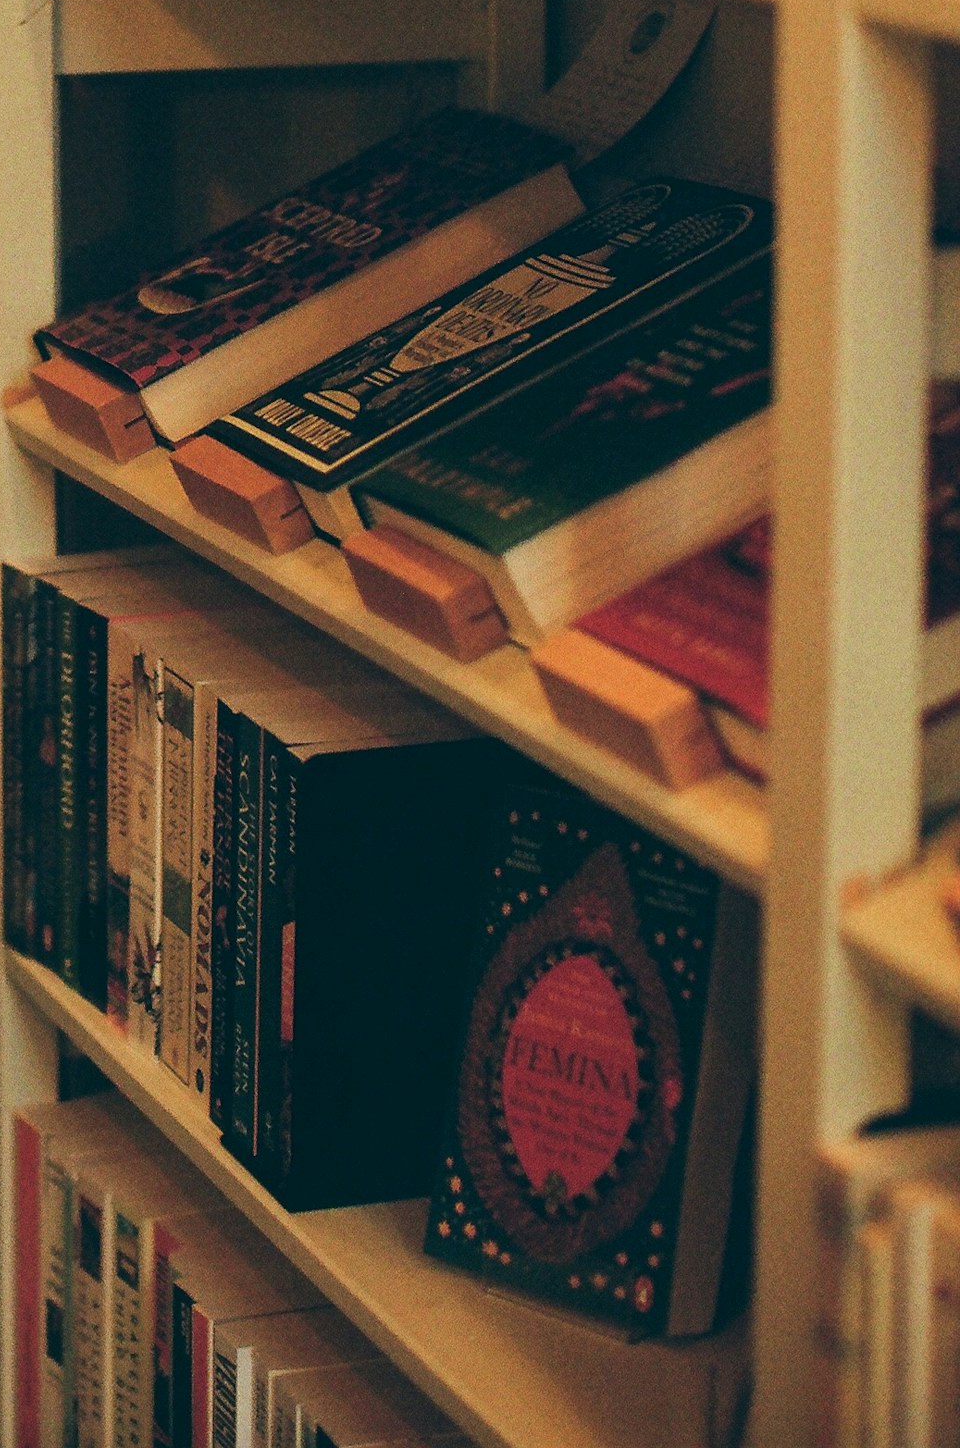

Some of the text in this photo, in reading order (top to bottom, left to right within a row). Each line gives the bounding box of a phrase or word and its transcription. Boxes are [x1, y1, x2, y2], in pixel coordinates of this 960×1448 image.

[233, 753, 251, 987] SCANDINAVIA
[266, 755, 279, 885] CAT JARMAN
[194, 873, 212, 1059] NOMADS
[510, 1036, 632, 1099] FEMINA
